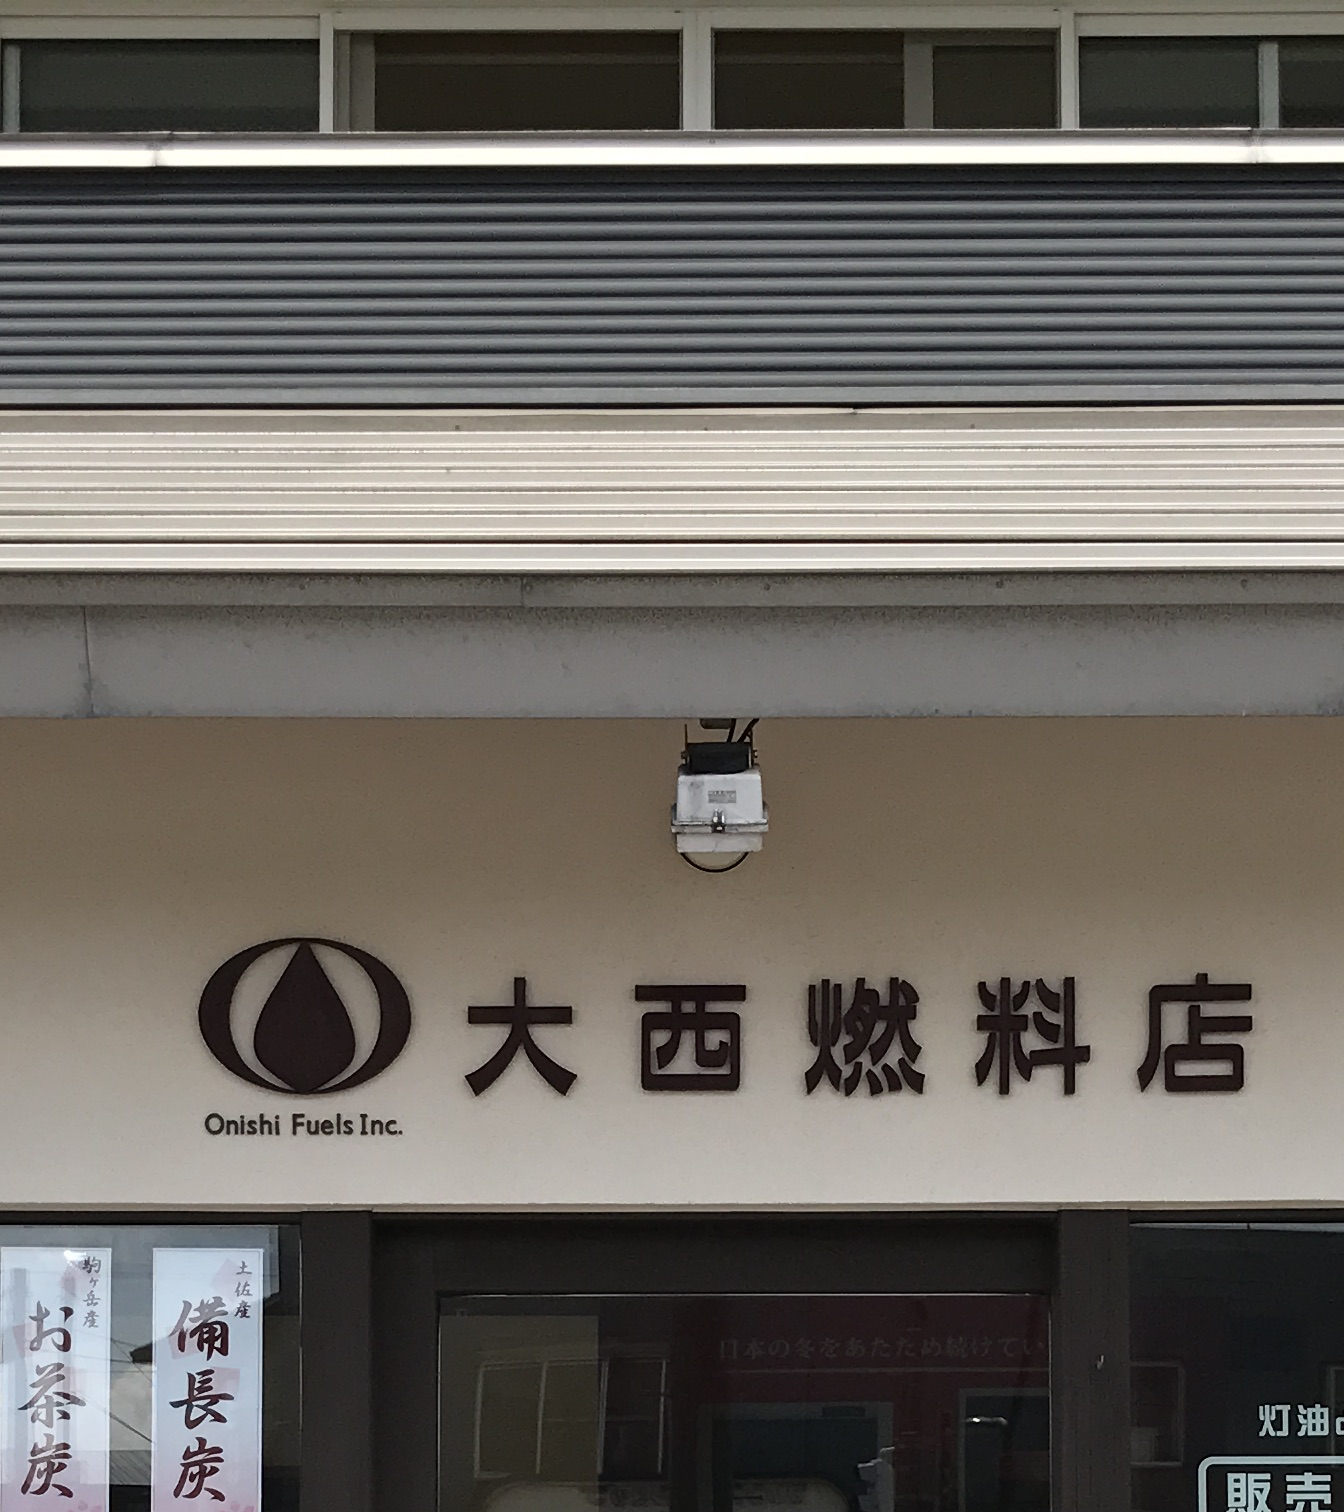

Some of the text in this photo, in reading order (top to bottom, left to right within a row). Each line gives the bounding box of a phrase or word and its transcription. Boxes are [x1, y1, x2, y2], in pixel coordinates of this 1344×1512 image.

[464, 972, 1253, 1096] 大西燃料店
[204, 1113, 403, 1136] Onishi Fuels Inc.
[234, 1260, 253, 1319] 土佐産
[18, 1305, 87, 1500] お茶炭
[168, 1296, 236, 1503] 備長炭
